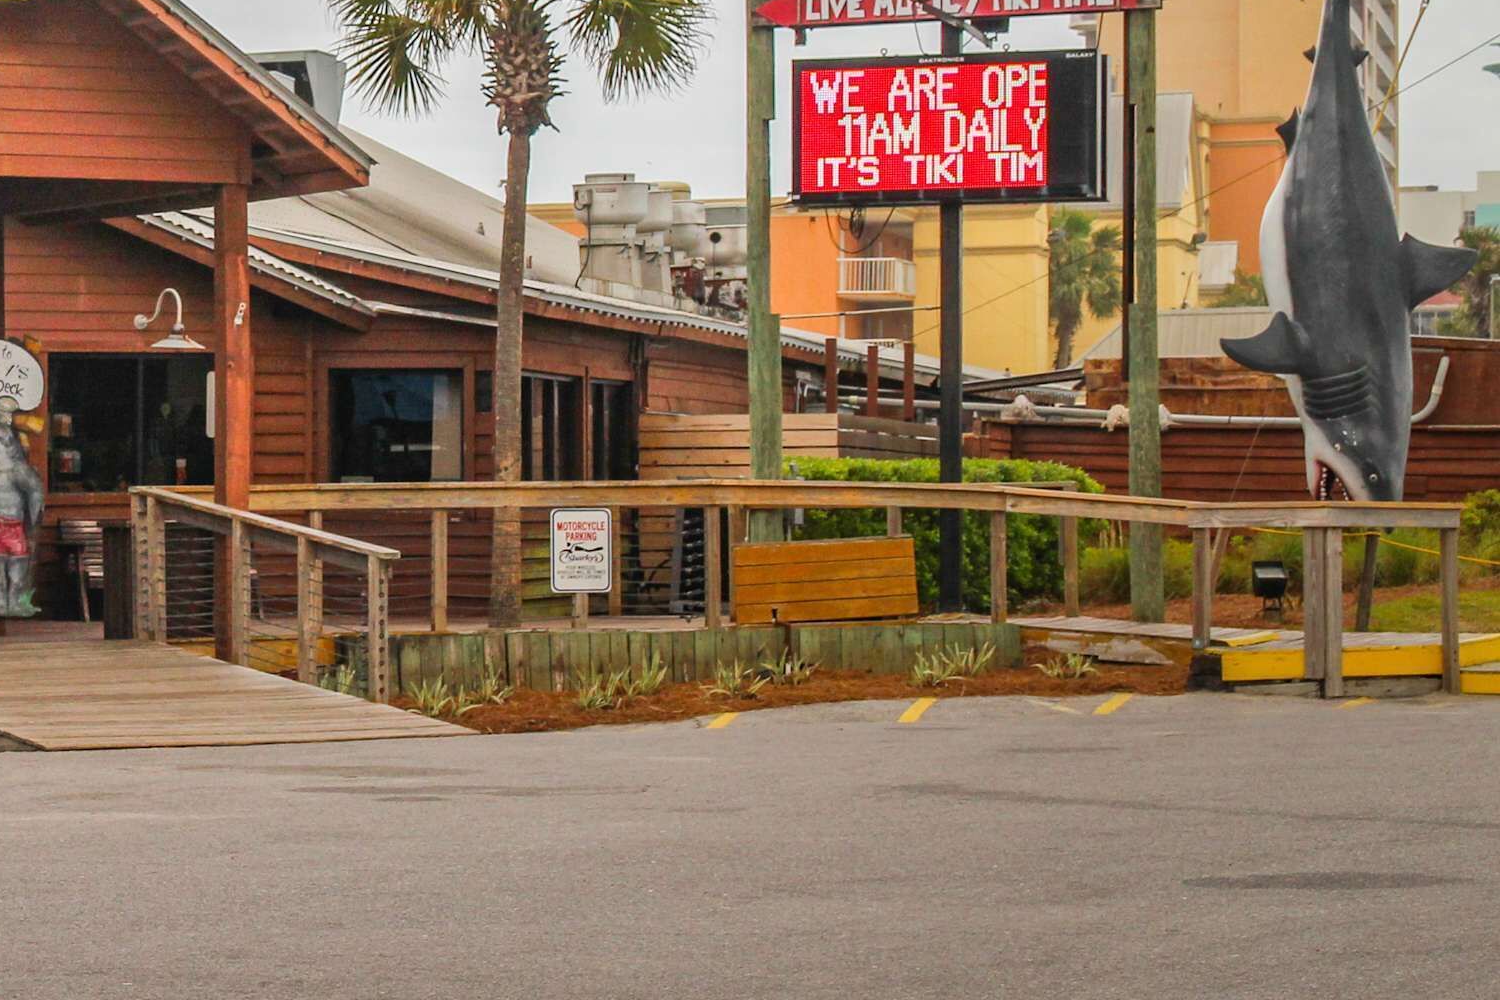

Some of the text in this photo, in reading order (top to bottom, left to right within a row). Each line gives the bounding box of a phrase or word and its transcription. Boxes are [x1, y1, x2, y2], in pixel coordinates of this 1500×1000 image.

[810, 63, 1048, 114] WE ARE OPE
[837, 107, 1046, 157] 11AM DAILY
[816, 150, 1044, 188] IT'S TIKI TIM
[2, 345, 12, 359] to
[556, 521, 606, 531] MOTORCYCLE
[565, 532, 597, 541] PARKING
